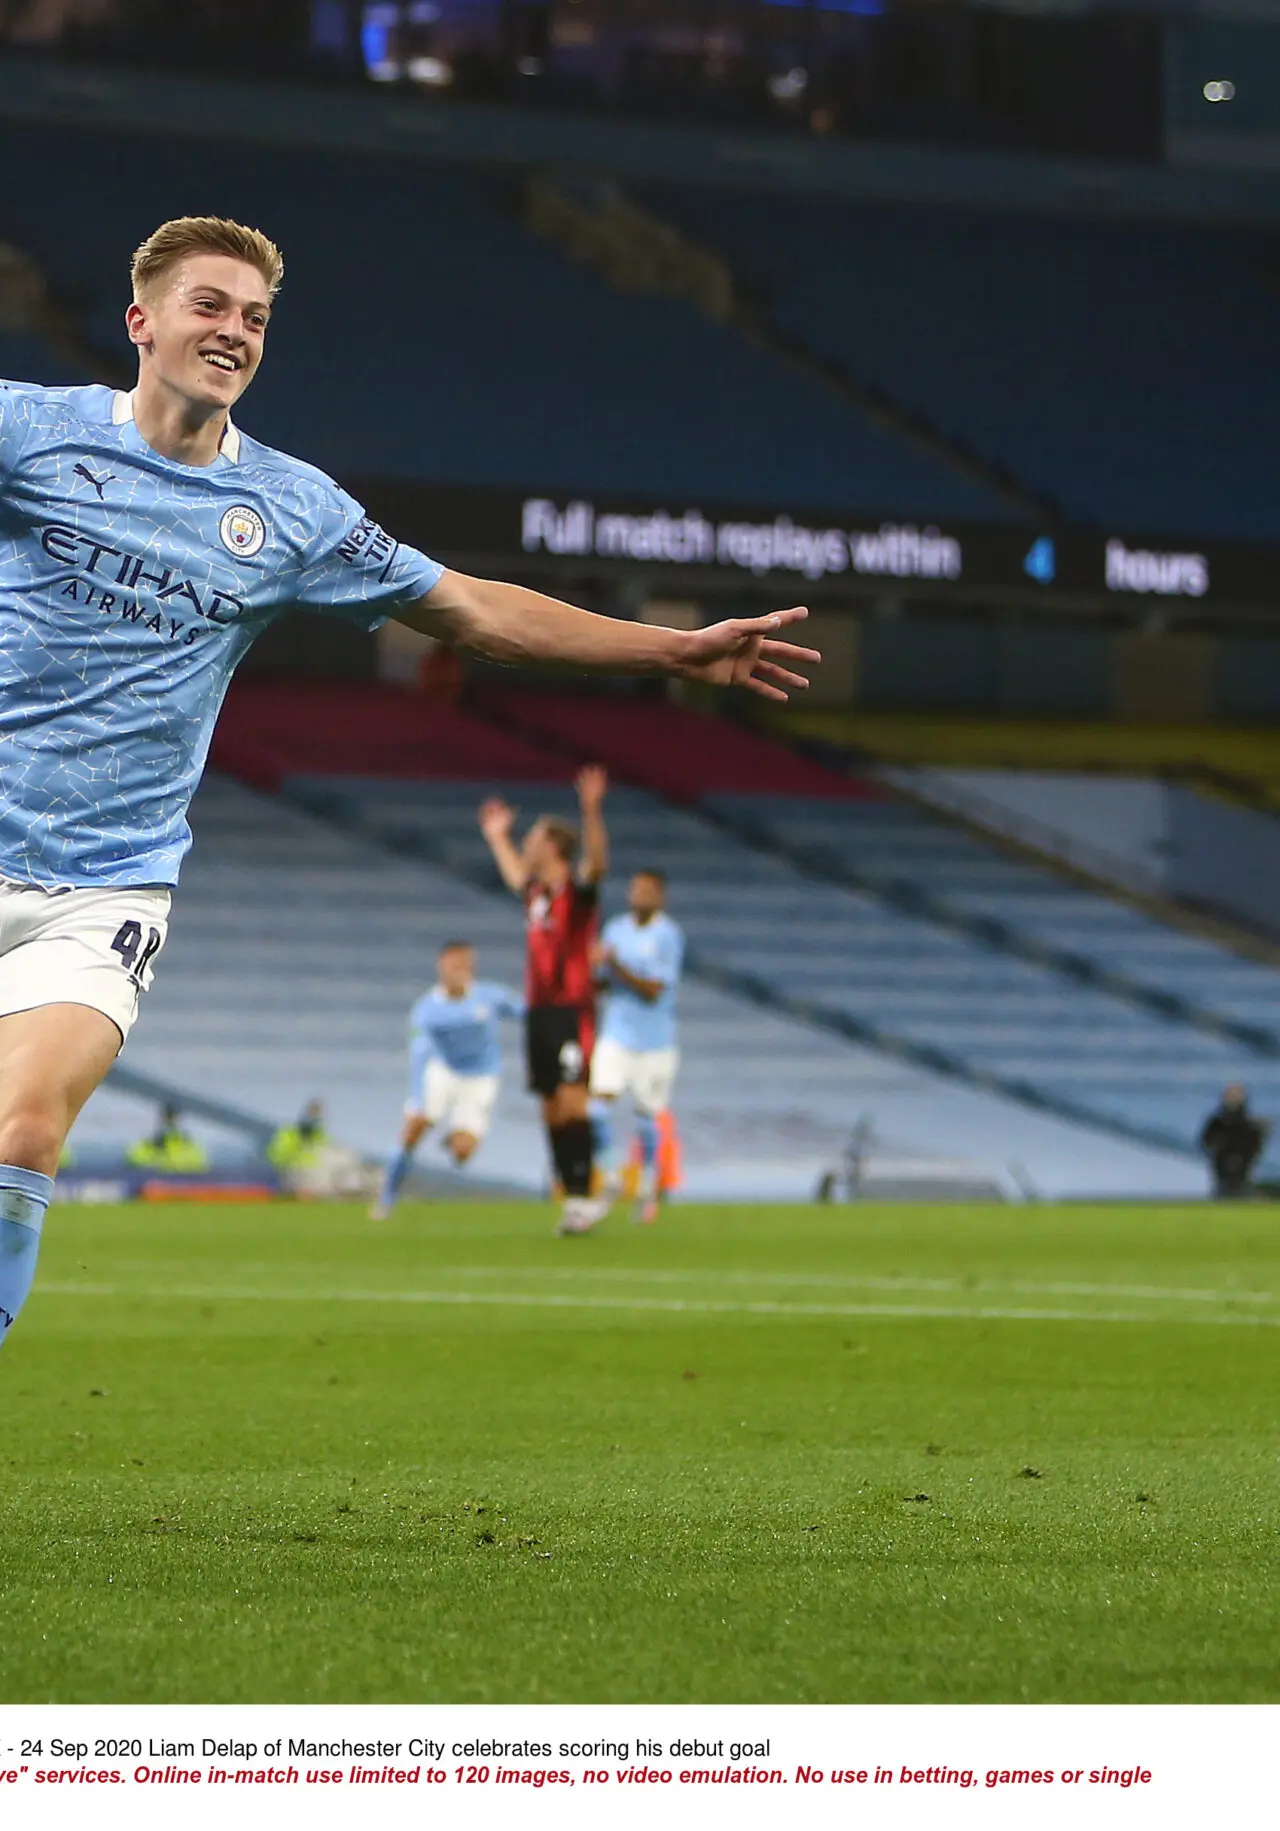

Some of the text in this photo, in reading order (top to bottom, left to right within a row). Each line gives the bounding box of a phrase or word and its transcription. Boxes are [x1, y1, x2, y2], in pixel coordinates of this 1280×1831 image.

[41, 524, 244, 625] ETIHAD
[522, 499, 1208, 597] Full match replays within 4 hours
[61, 580, 200, 646] AIRWAYS
